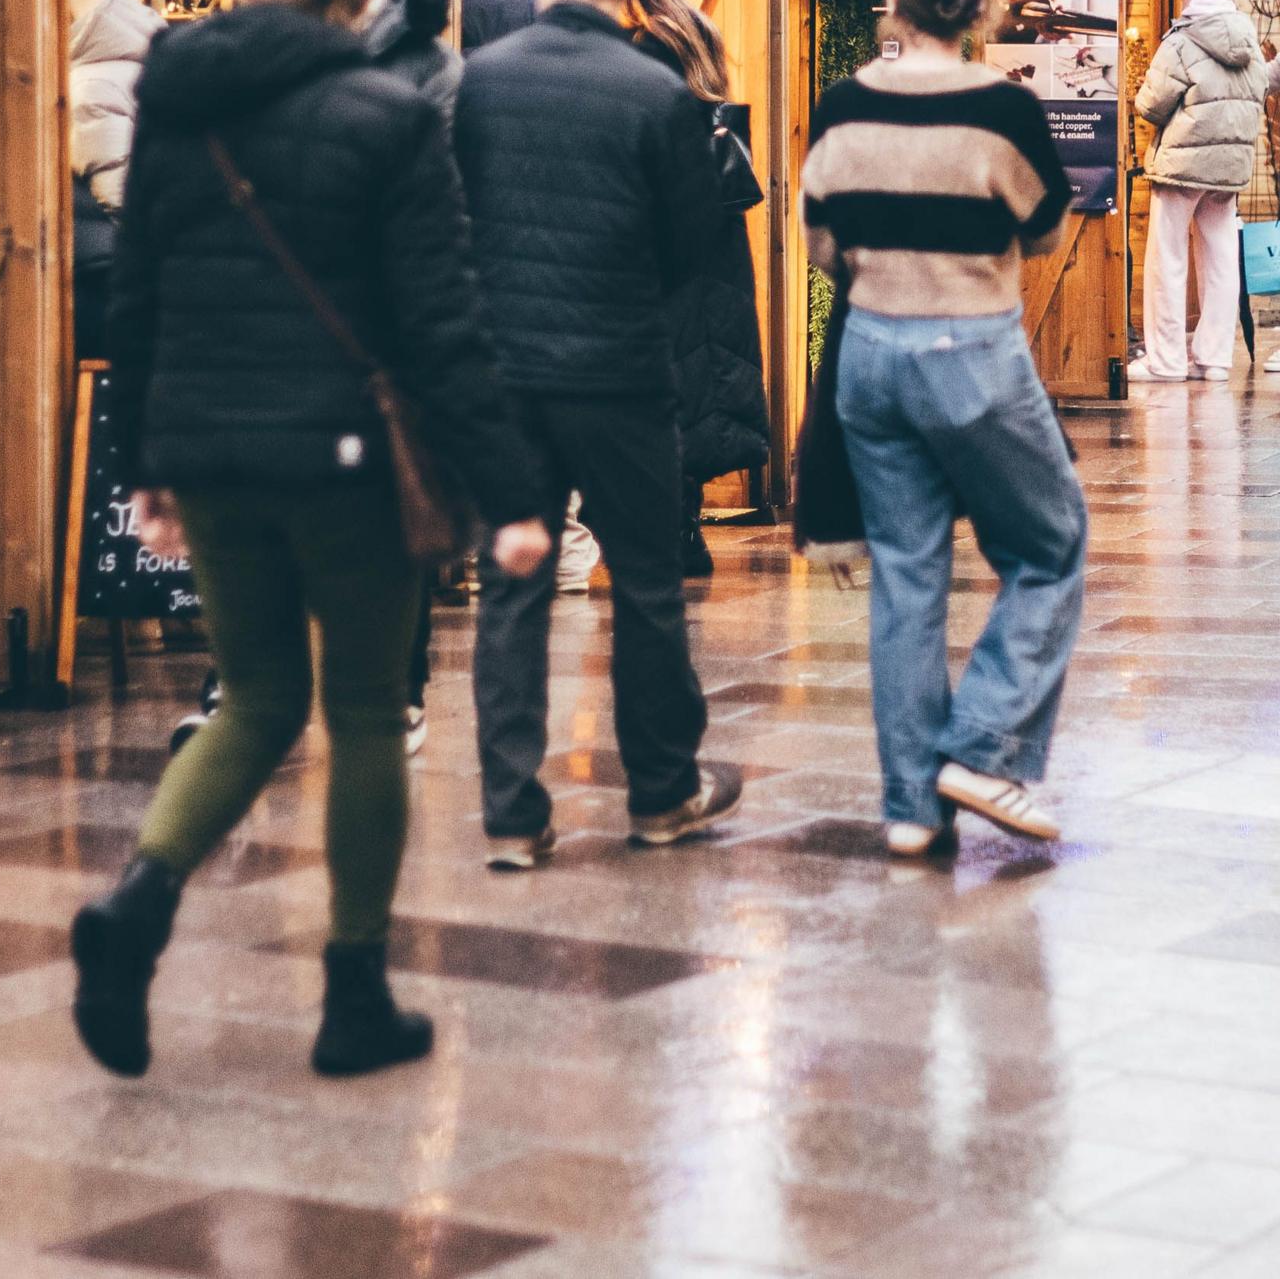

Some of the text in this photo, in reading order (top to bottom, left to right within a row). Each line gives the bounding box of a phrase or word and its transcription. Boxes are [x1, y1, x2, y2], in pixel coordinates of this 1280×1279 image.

[1061, 111, 1102, 121] handmade
[1059, 131, 1066, 139] &
[1066, 131, 1095, 140] enamel
